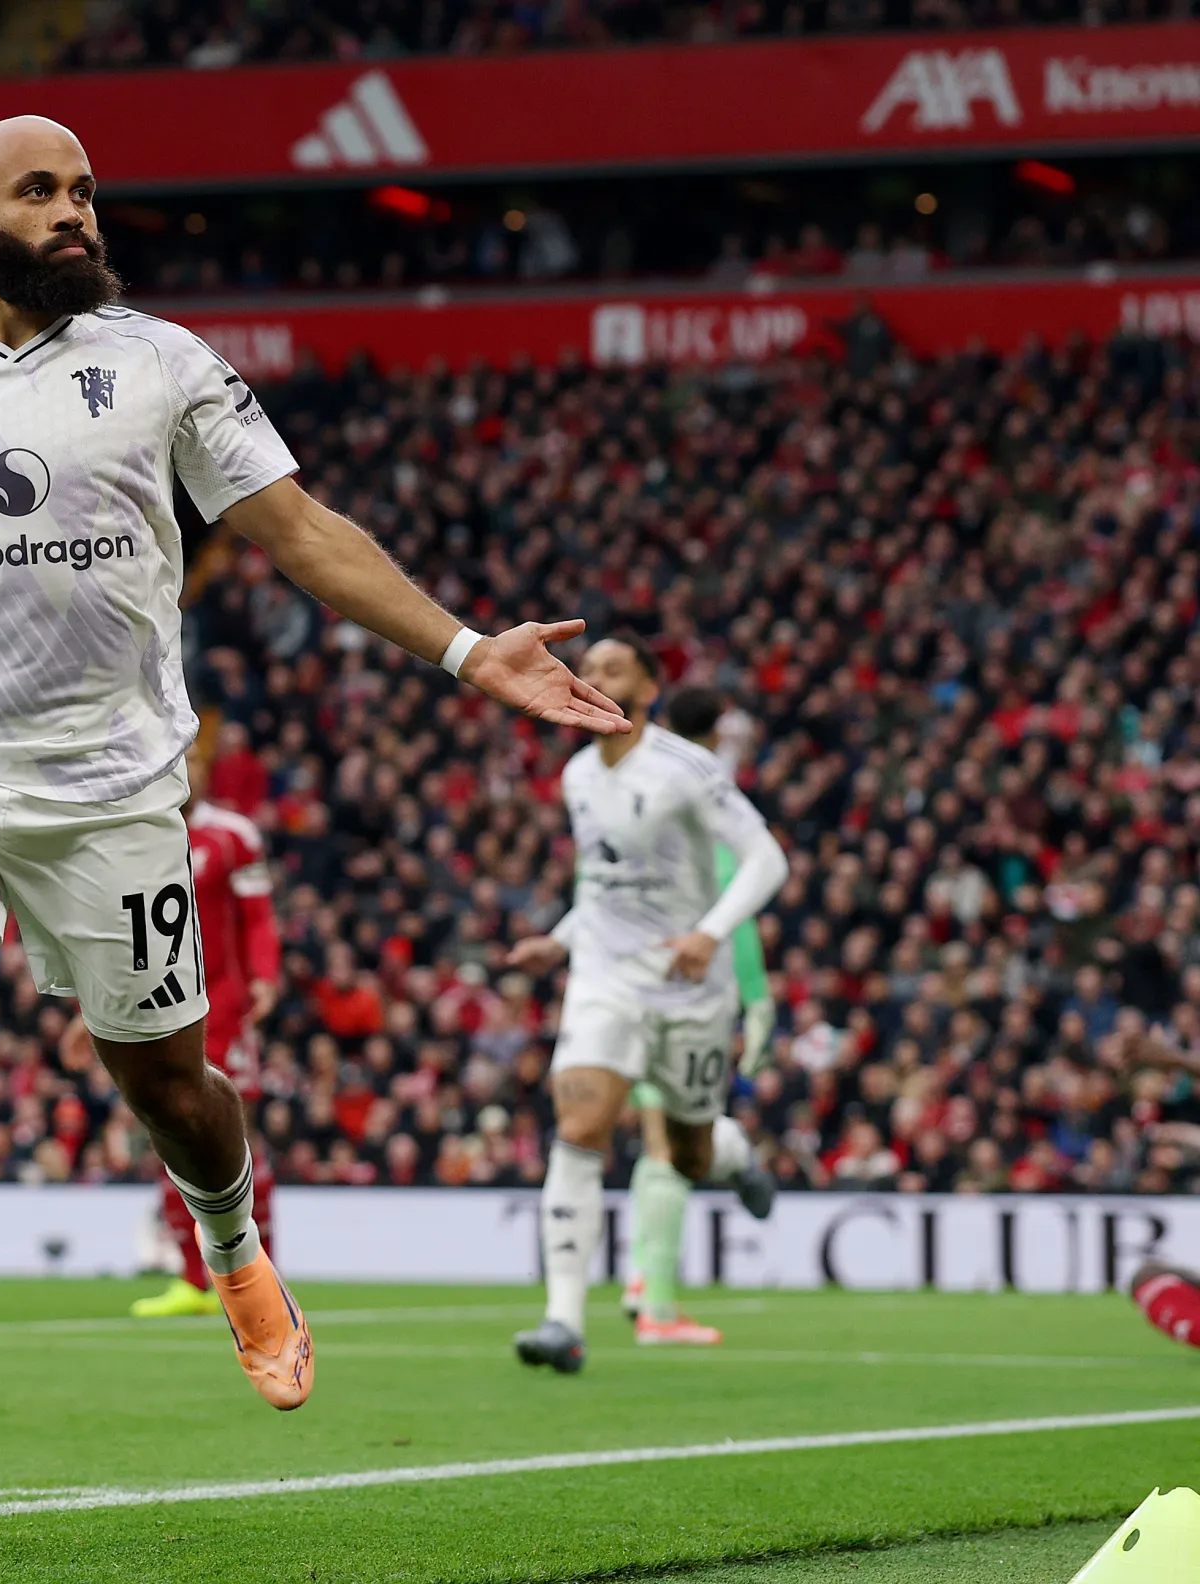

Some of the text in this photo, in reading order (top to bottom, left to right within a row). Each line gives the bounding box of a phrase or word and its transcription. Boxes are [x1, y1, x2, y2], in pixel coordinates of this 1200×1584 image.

[861, 47, 1022, 132] AXA
[122, 883, 188, 971] 19
[684, 1047, 723, 1088] 10
[818, 1200, 1168, 1294] CLUB
